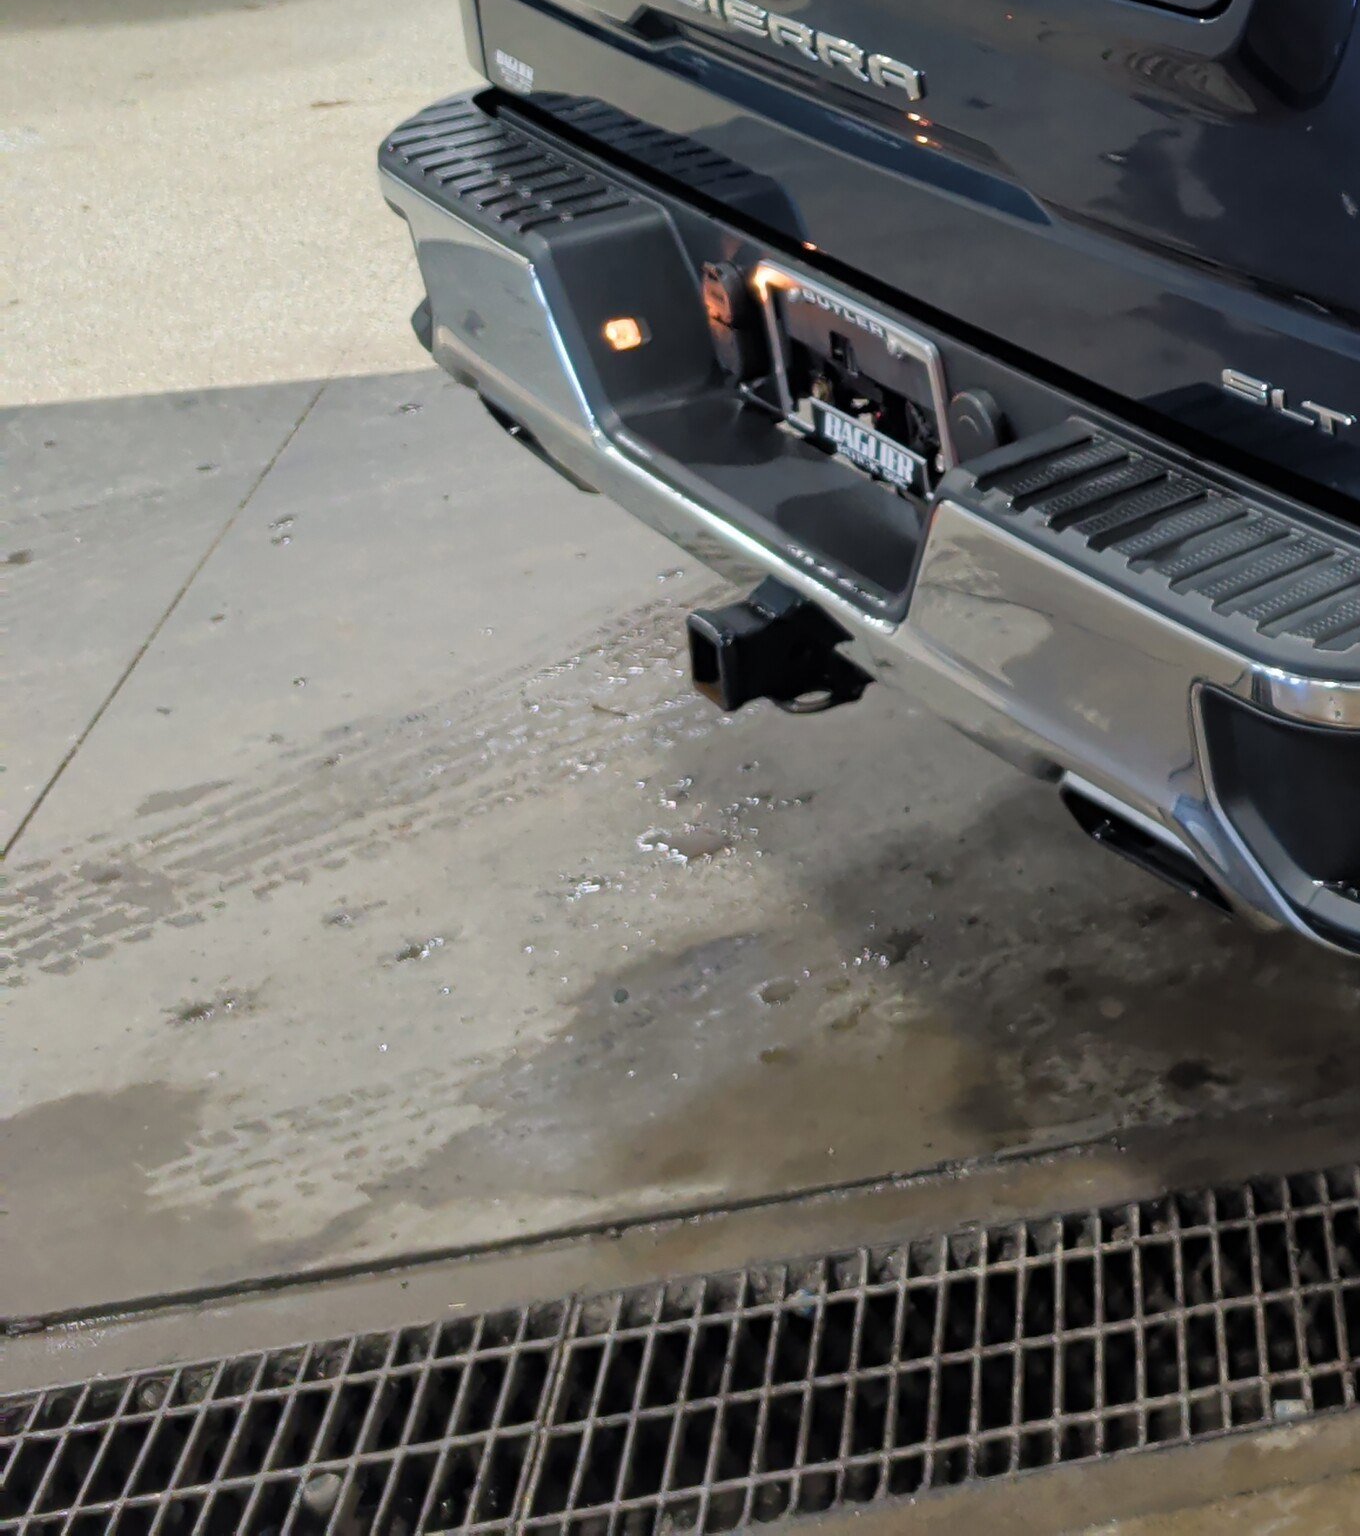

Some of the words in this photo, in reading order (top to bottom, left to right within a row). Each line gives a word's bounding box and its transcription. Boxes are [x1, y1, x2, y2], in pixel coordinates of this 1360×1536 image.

[802, 287, 885, 339] BUTLER
[1221, 368, 1354, 436] SLT
[823, 411, 915, 485] BAGLIER
